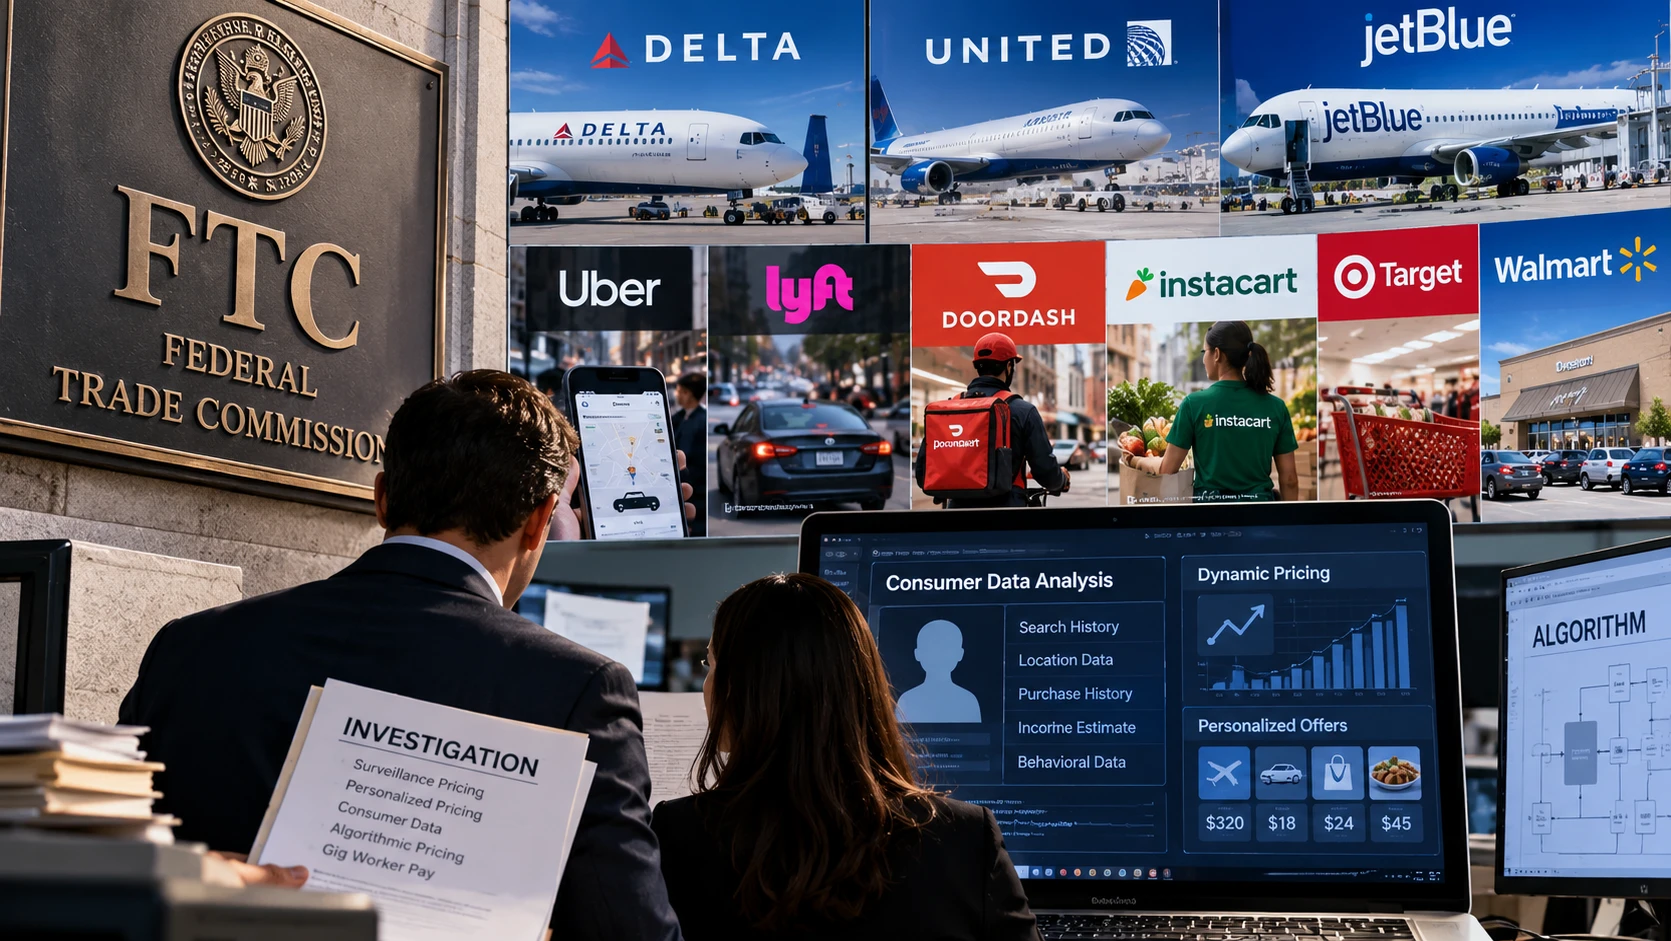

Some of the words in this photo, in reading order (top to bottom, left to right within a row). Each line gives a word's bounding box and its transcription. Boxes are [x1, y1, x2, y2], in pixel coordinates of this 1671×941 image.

[645, 31, 801, 63] DELTA
[925, 32, 1111, 65] UNITED
[1361, 6, 1512, 68] jetBlue
[582, 122, 666, 137] DELTA
[1323, 101, 1423, 144] jetBlue
[113, 184, 361, 350] FTC
[1379, 259, 1463, 292] Target
[1494, 248, 1613, 284] Walmart
[559, 269, 662, 307] Uber
[765, 263, 854, 325] lyft
[1159, 267, 1298, 299] instacart
[942, 308, 1076, 329] DOORDASH
[162, 332, 318, 399] FEDERAL
[52, 365, 184, 424] TRADE
[1215, 414, 1272, 429] instacart
[886, 574, 983, 592] Consumer
[987, 573, 1031, 590] Data
[1035, 571, 1114, 593] Analysis
[1198, 566, 1270, 585] Dynamic
[1274, 565, 1331, 583] Pricing
[1019, 620, 1067, 634] Search
[1070, 620, 1120, 636] History
[1532, 609, 1646, 649] ALGORITHM
[1019, 653, 1078, 667] Location
[1081, 653, 1114, 666] Data
[1018, 687, 1081, 701] Purchase
[1084, 687, 1133, 703] History
[1076, 721, 1137, 734] Estimate
[1198, 717, 1296, 733] Personalized
[1300, 717, 1348, 733] Offers
[343, 716, 540, 778] INVESTIGATION
[1018, 755, 1090, 769] Behavioral
[1094, 755, 1126, 769] Data
[353, 758, 435, 787] Surveillance
[438, 777, 485, 801] Pricing
[345, 779, 434, 810] Personalized
[435, 800, 484, 823] Pricing
[338, 800, 408, 826] Consumer
[410, 817, 443, 835] Data
[1206, 814, 1244, 832] $320
[1268, 814, 1296, 832] $18
[1324, 814, 1354, 832] $24
[1381, 814, 1412, 832] $45
[322, 843, 348, 862] Gig
[352, 849, 406, 873] Worker
[408, 863, 436, 881] Pay
[415, 841, 465, 866] Pricing
